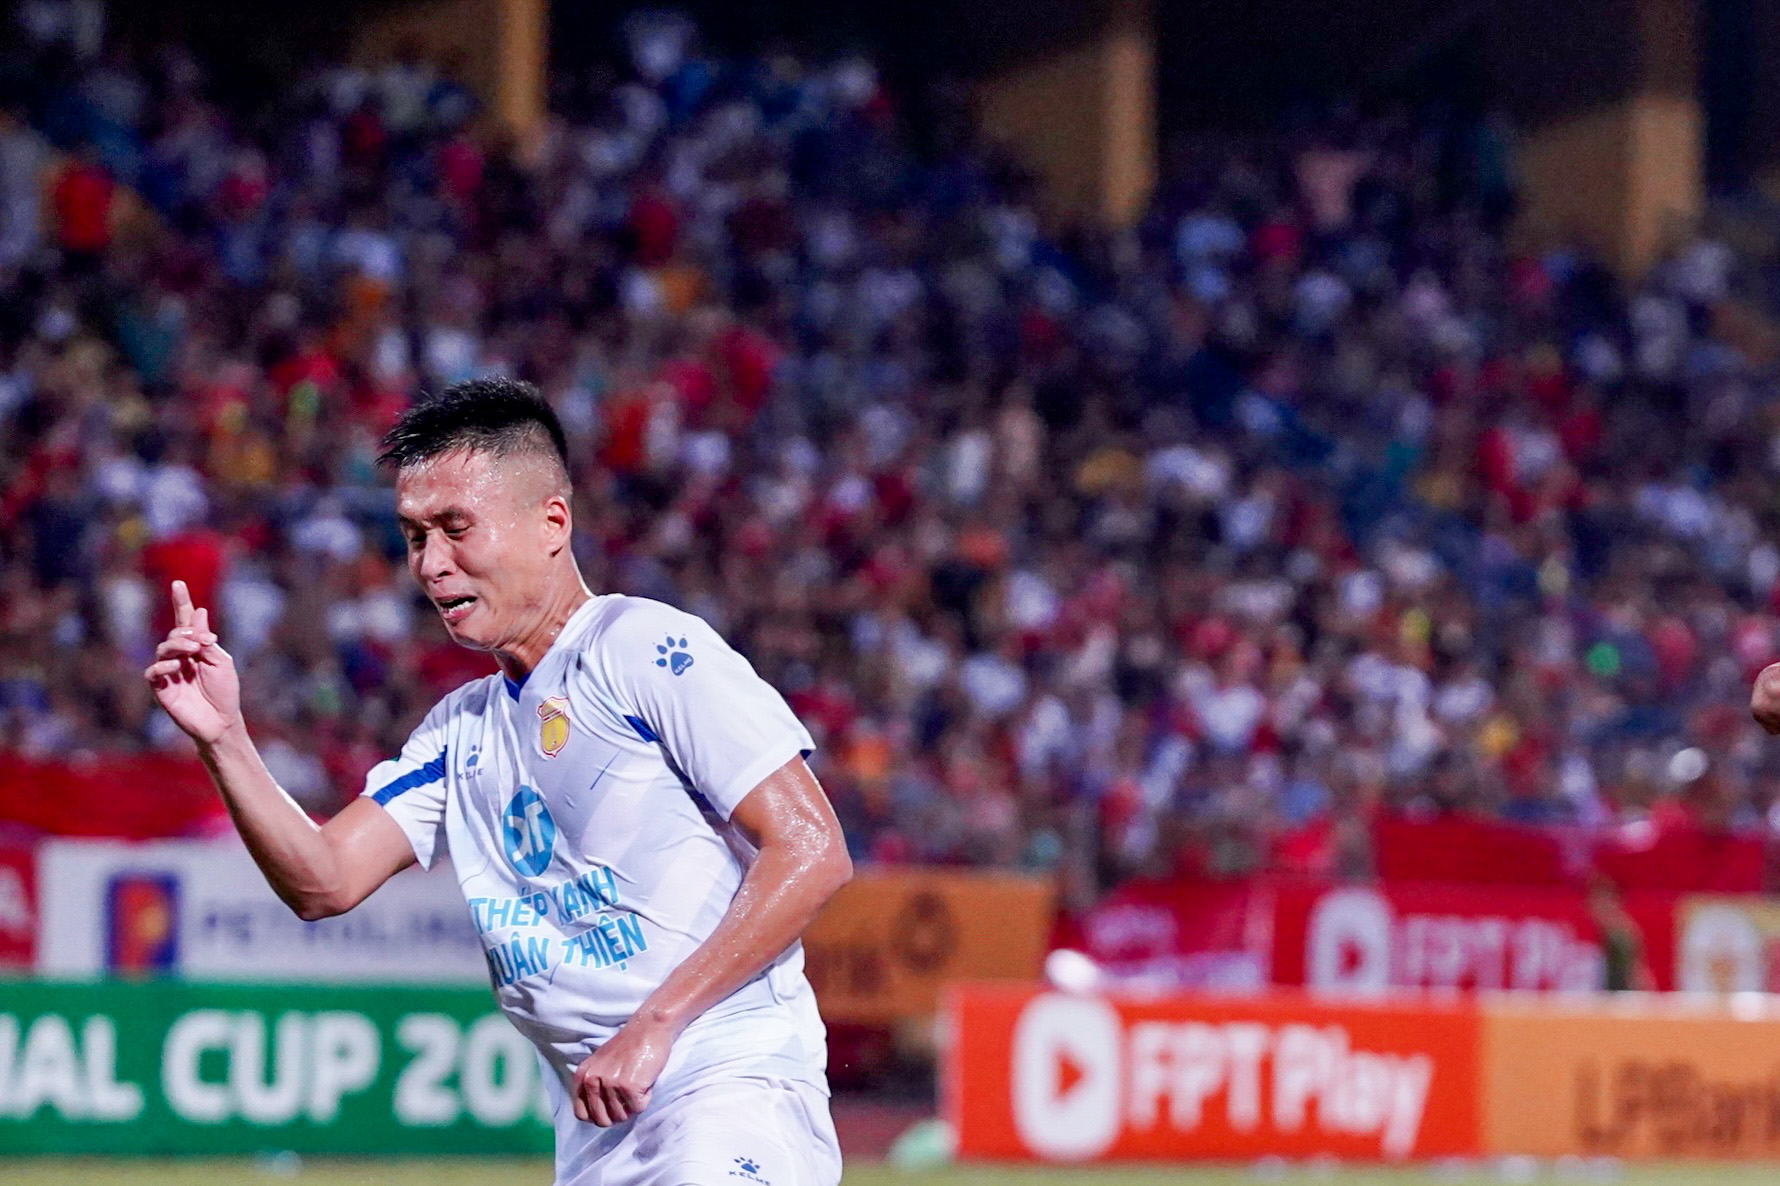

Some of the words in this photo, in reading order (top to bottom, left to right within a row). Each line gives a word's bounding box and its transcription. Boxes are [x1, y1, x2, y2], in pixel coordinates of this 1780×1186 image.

[545, 865, 619, 927] XANH
[560, 912, 648, 971] THIỆN
[161, 1008, 381, 1124] CUP
[1126, 1018, 1272, 1134] FPT
[1271, 1021, 1436, 1158] Play
[728, 1170, 771, 1186] KELME
